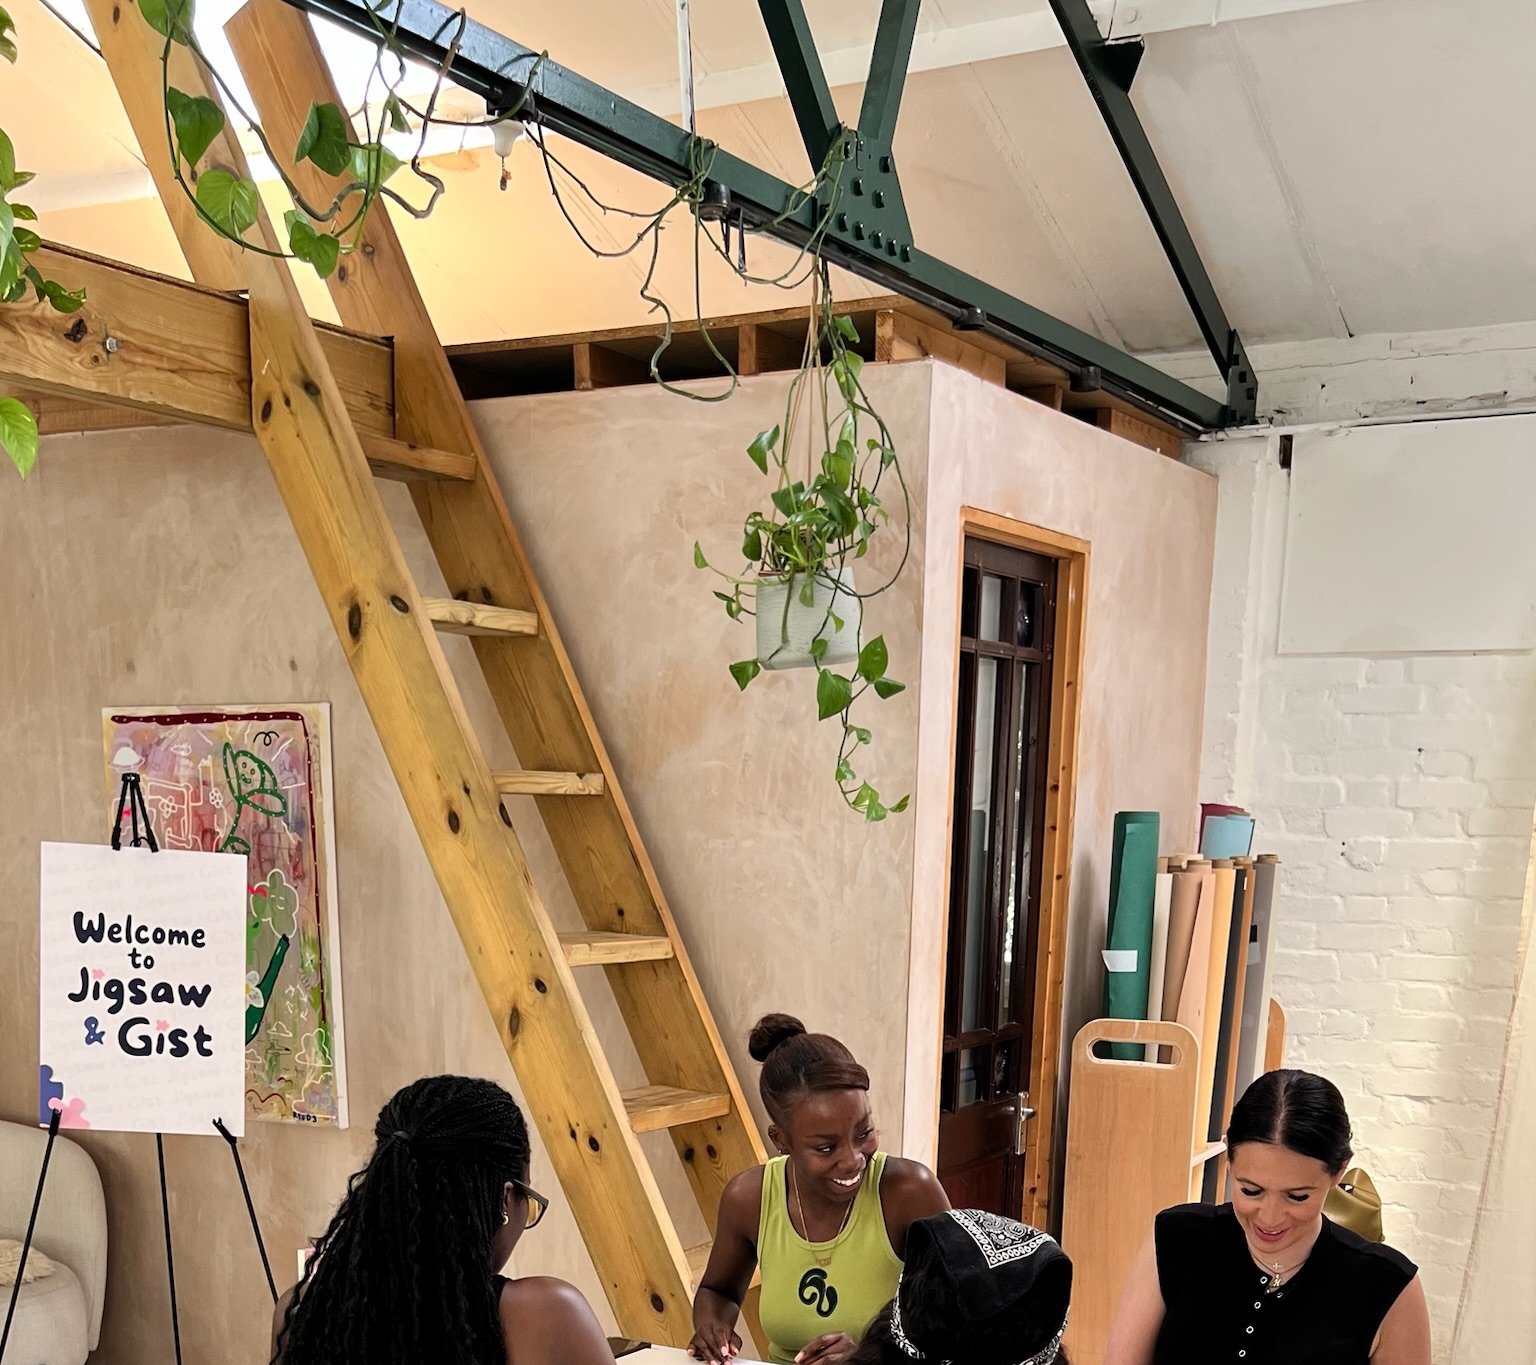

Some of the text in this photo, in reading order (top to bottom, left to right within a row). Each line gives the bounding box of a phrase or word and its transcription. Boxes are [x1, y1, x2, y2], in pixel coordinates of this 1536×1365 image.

[73, 911, 206, 948] Welcome
[128, 948, 155, 970] to
[68, 966, 212, 1015] Jigsaw
[84, 1016, 213, 1058] & Gist
